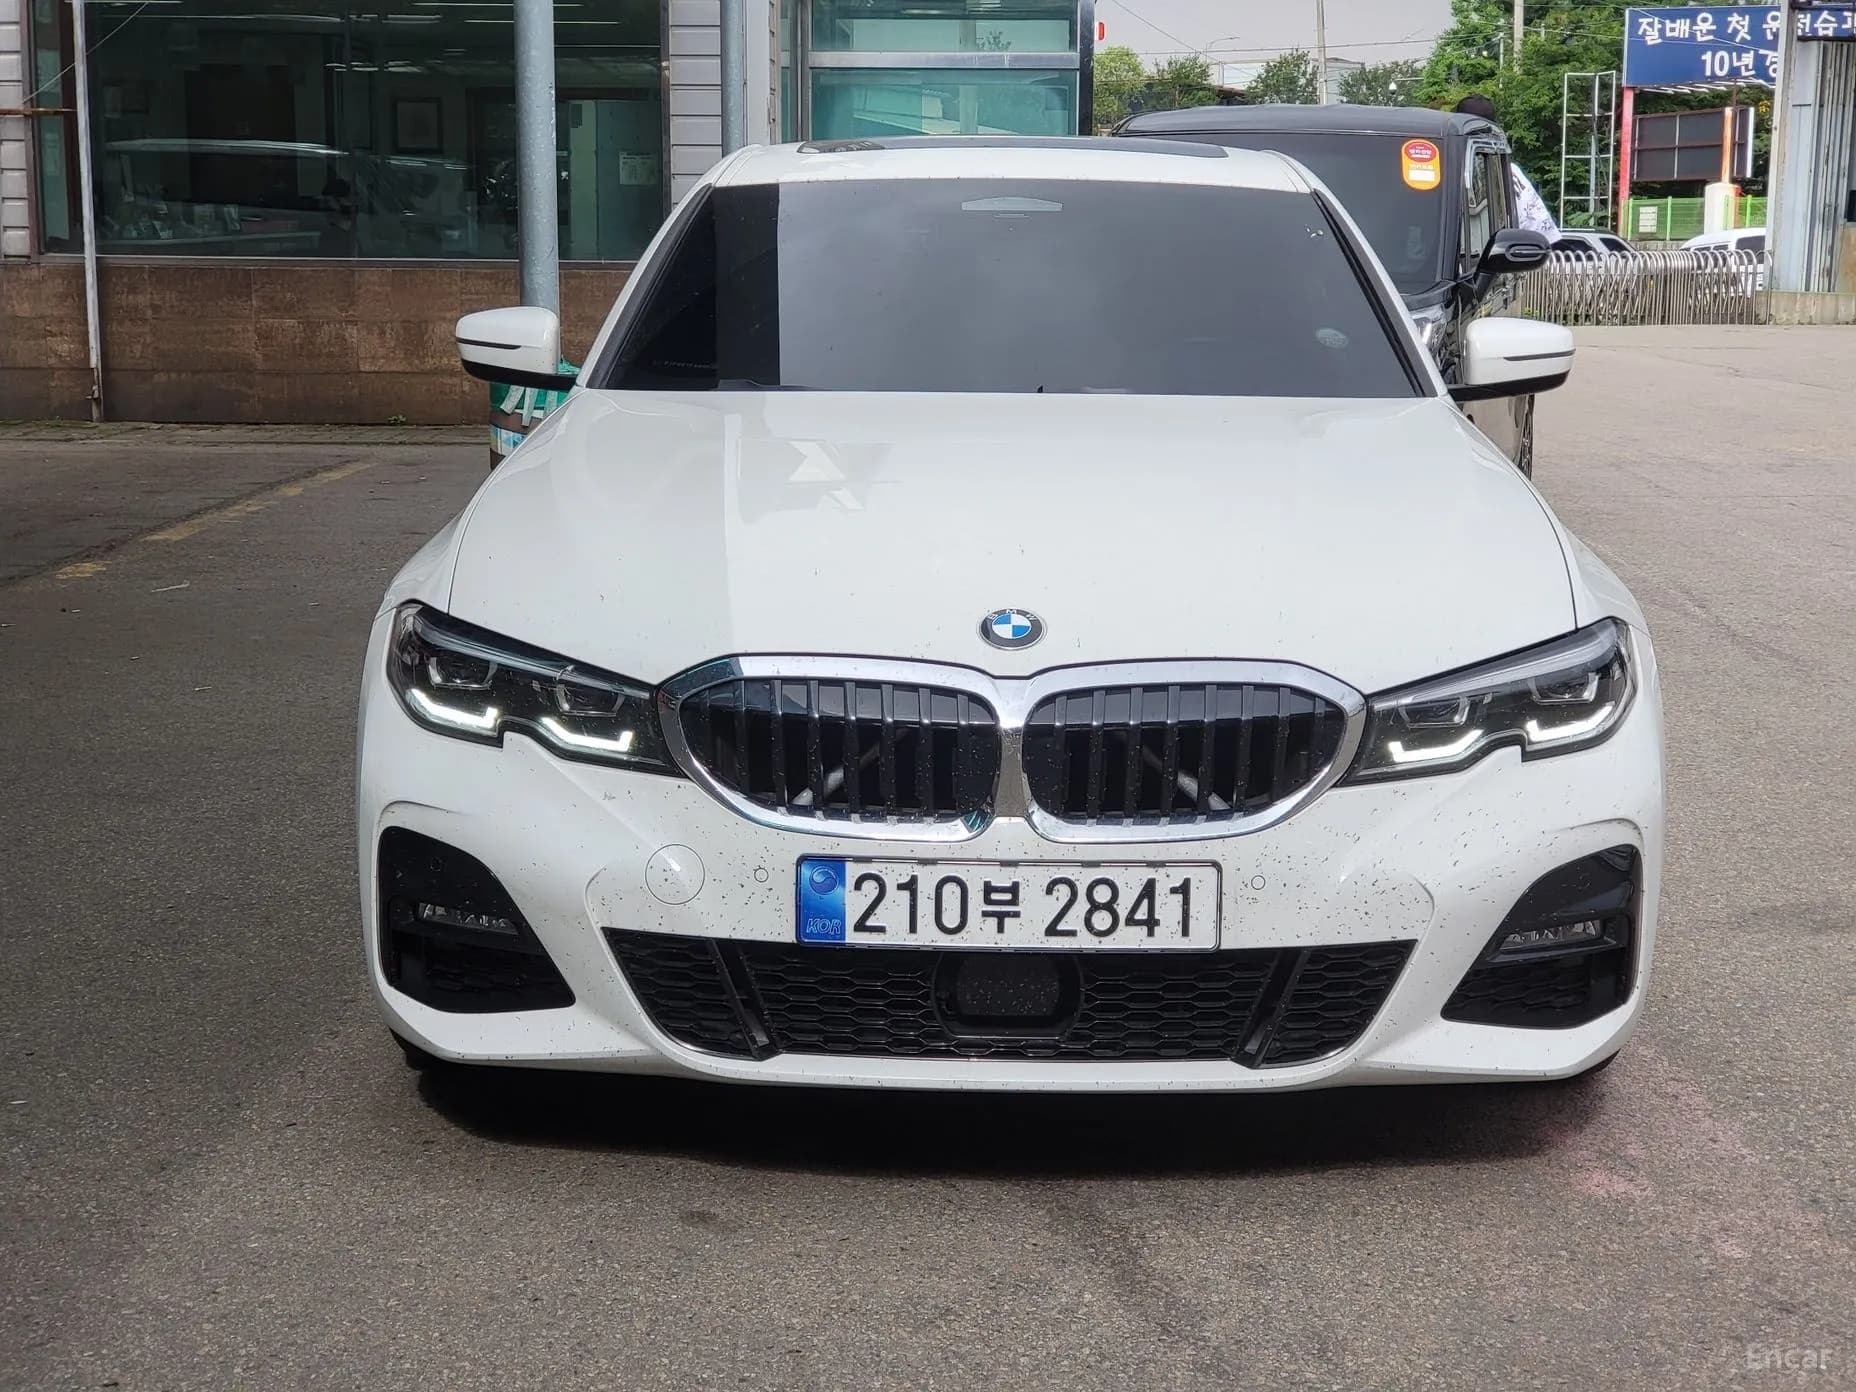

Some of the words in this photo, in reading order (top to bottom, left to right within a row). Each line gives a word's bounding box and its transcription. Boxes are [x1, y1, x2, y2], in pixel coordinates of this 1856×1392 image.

[1638, 12, 1717, 45] 잘배운
[1727, 12, 1752, 42] 첫
[853, 872, 1021, 935] 210부
[1044, 876, 1192, 938] 2841
[806, 918, 842, 935] KOR
